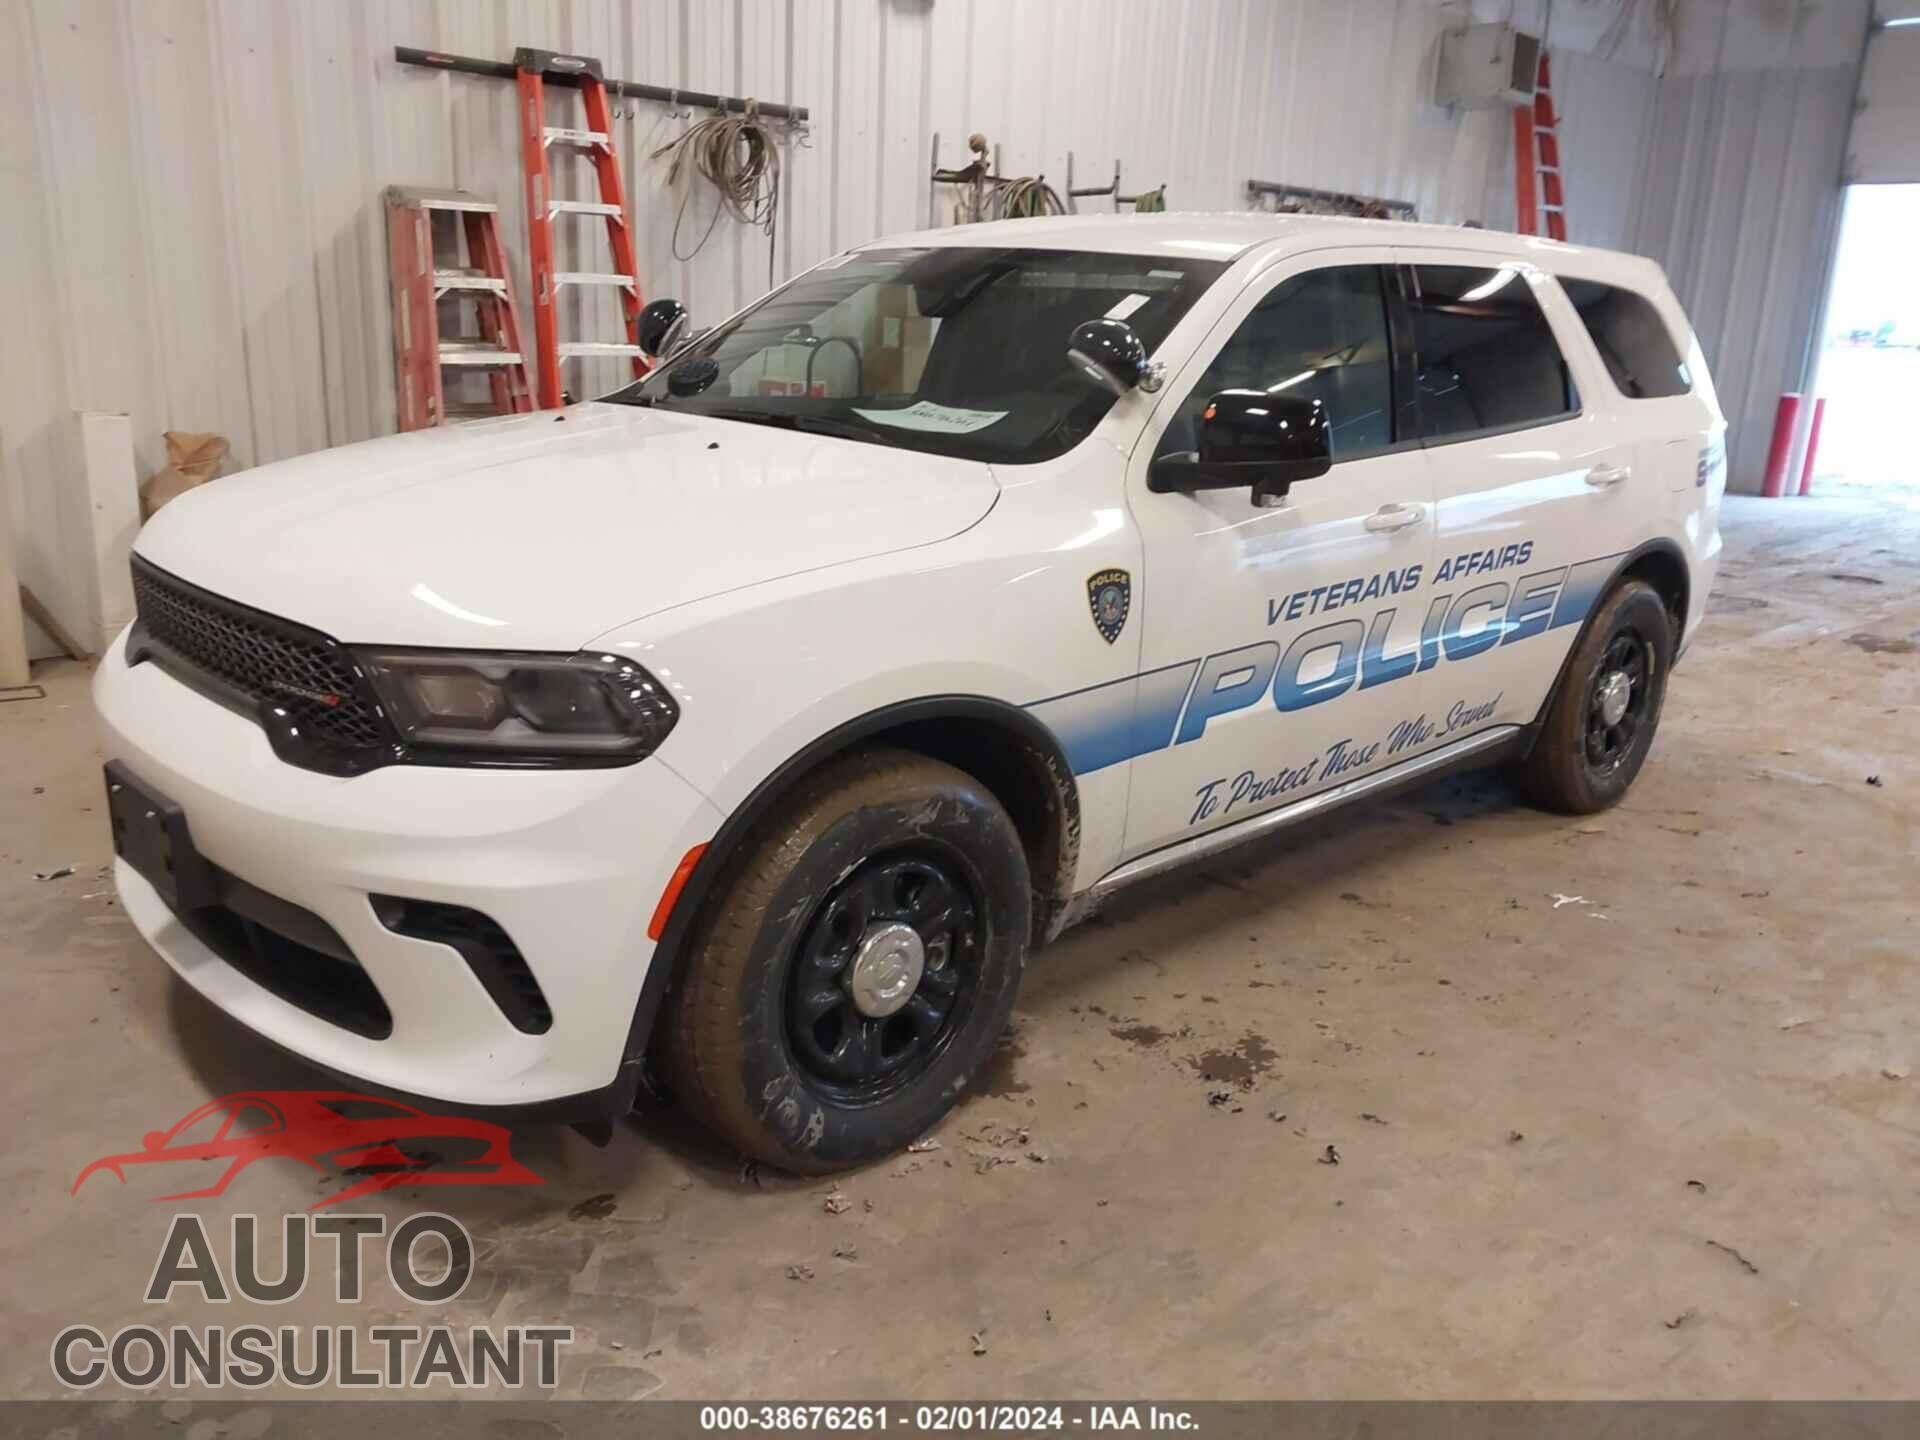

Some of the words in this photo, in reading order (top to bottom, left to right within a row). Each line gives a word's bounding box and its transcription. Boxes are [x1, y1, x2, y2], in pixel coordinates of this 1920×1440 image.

[1089, 573, 1127, 590] POLICE
[1267, 565, 1423, 625] VETERANS
[1432, 540, 1533, 584] AFFAIRS
[1175, 568, 1565, 745] POLICE
[1189, 778, 1226, 825] To
[1224, 758, 1319, 813] Protect
[1318, 738, 1380, 782] Those
[1387, 713, 1435, 754] Who
[1435, 690, 1504, 738] Served
